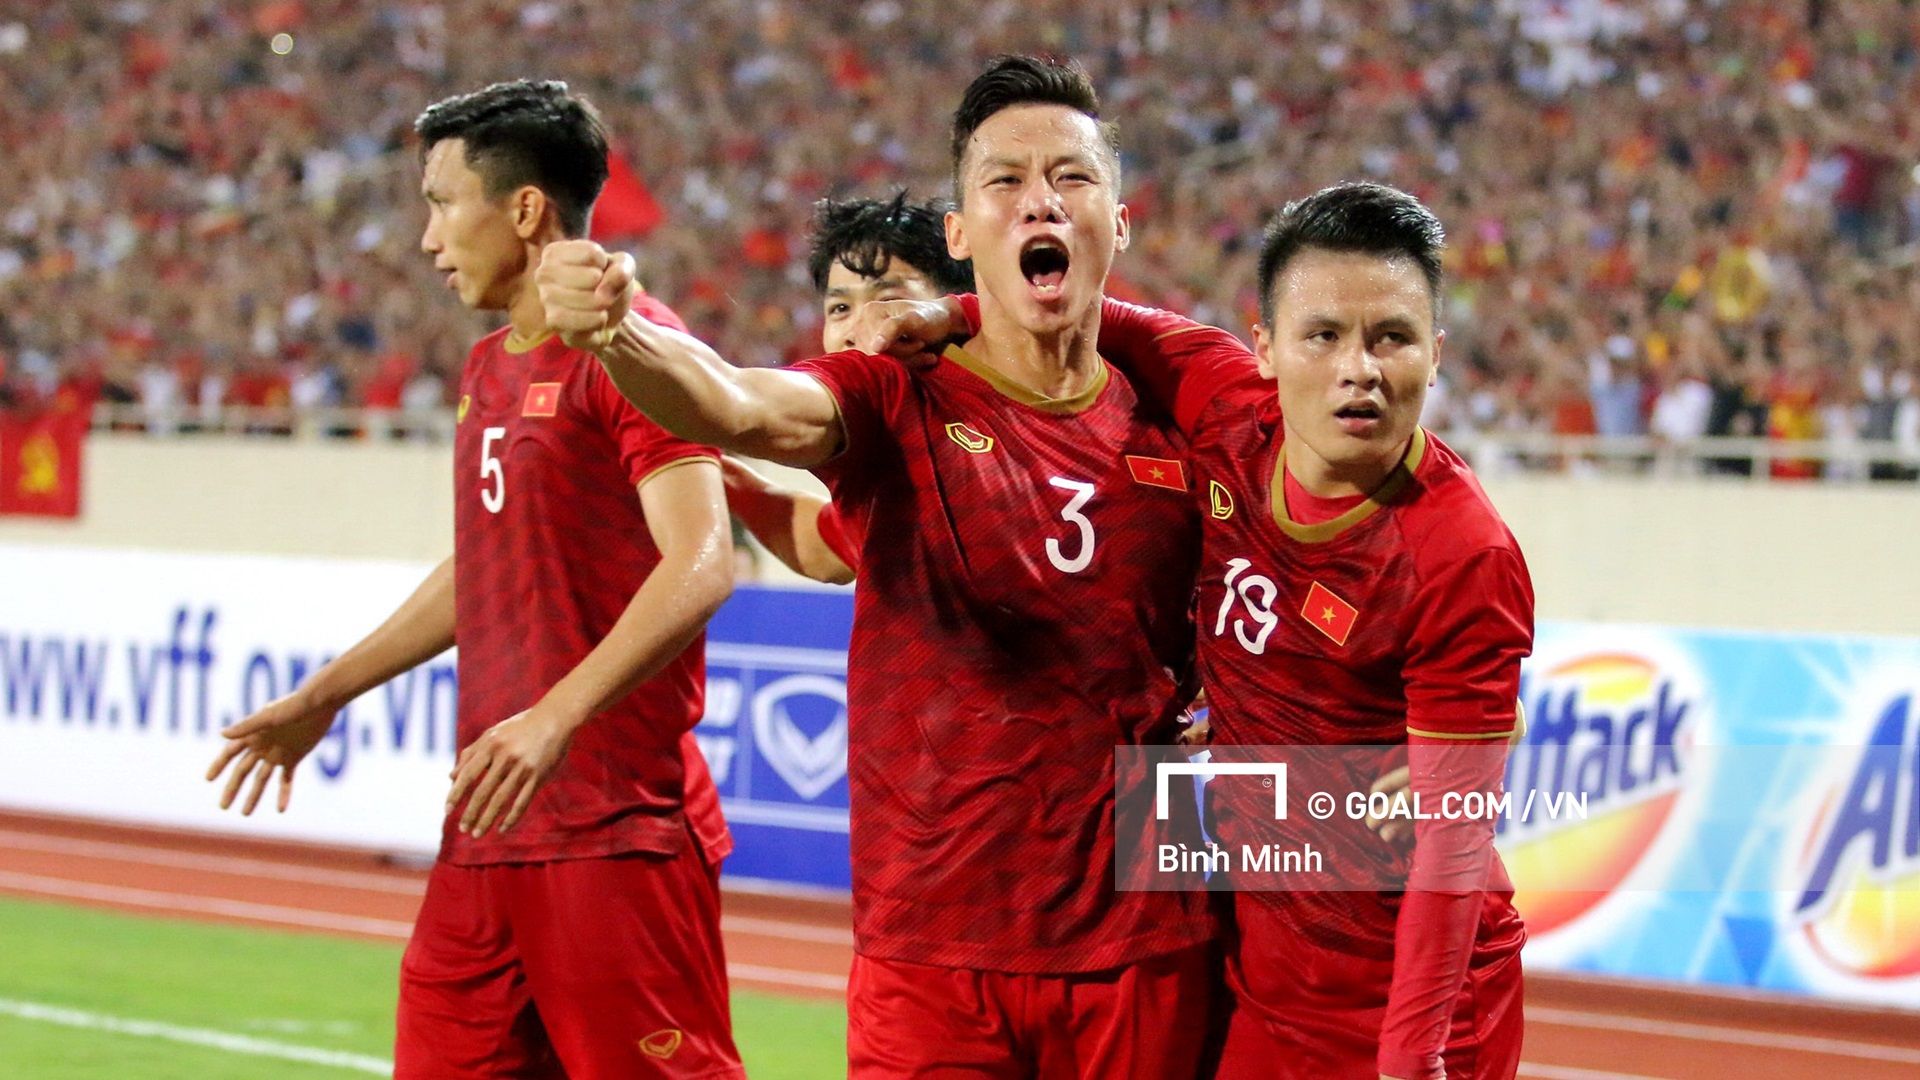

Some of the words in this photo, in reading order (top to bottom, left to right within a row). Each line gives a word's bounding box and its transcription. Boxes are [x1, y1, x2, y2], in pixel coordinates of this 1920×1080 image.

[480, 427, 506, 514] 5
[1045, 476, 1096, 573] 3
[1214, 557, 1279, 655] 19
[1496, 676, 1689, 834] ttack
